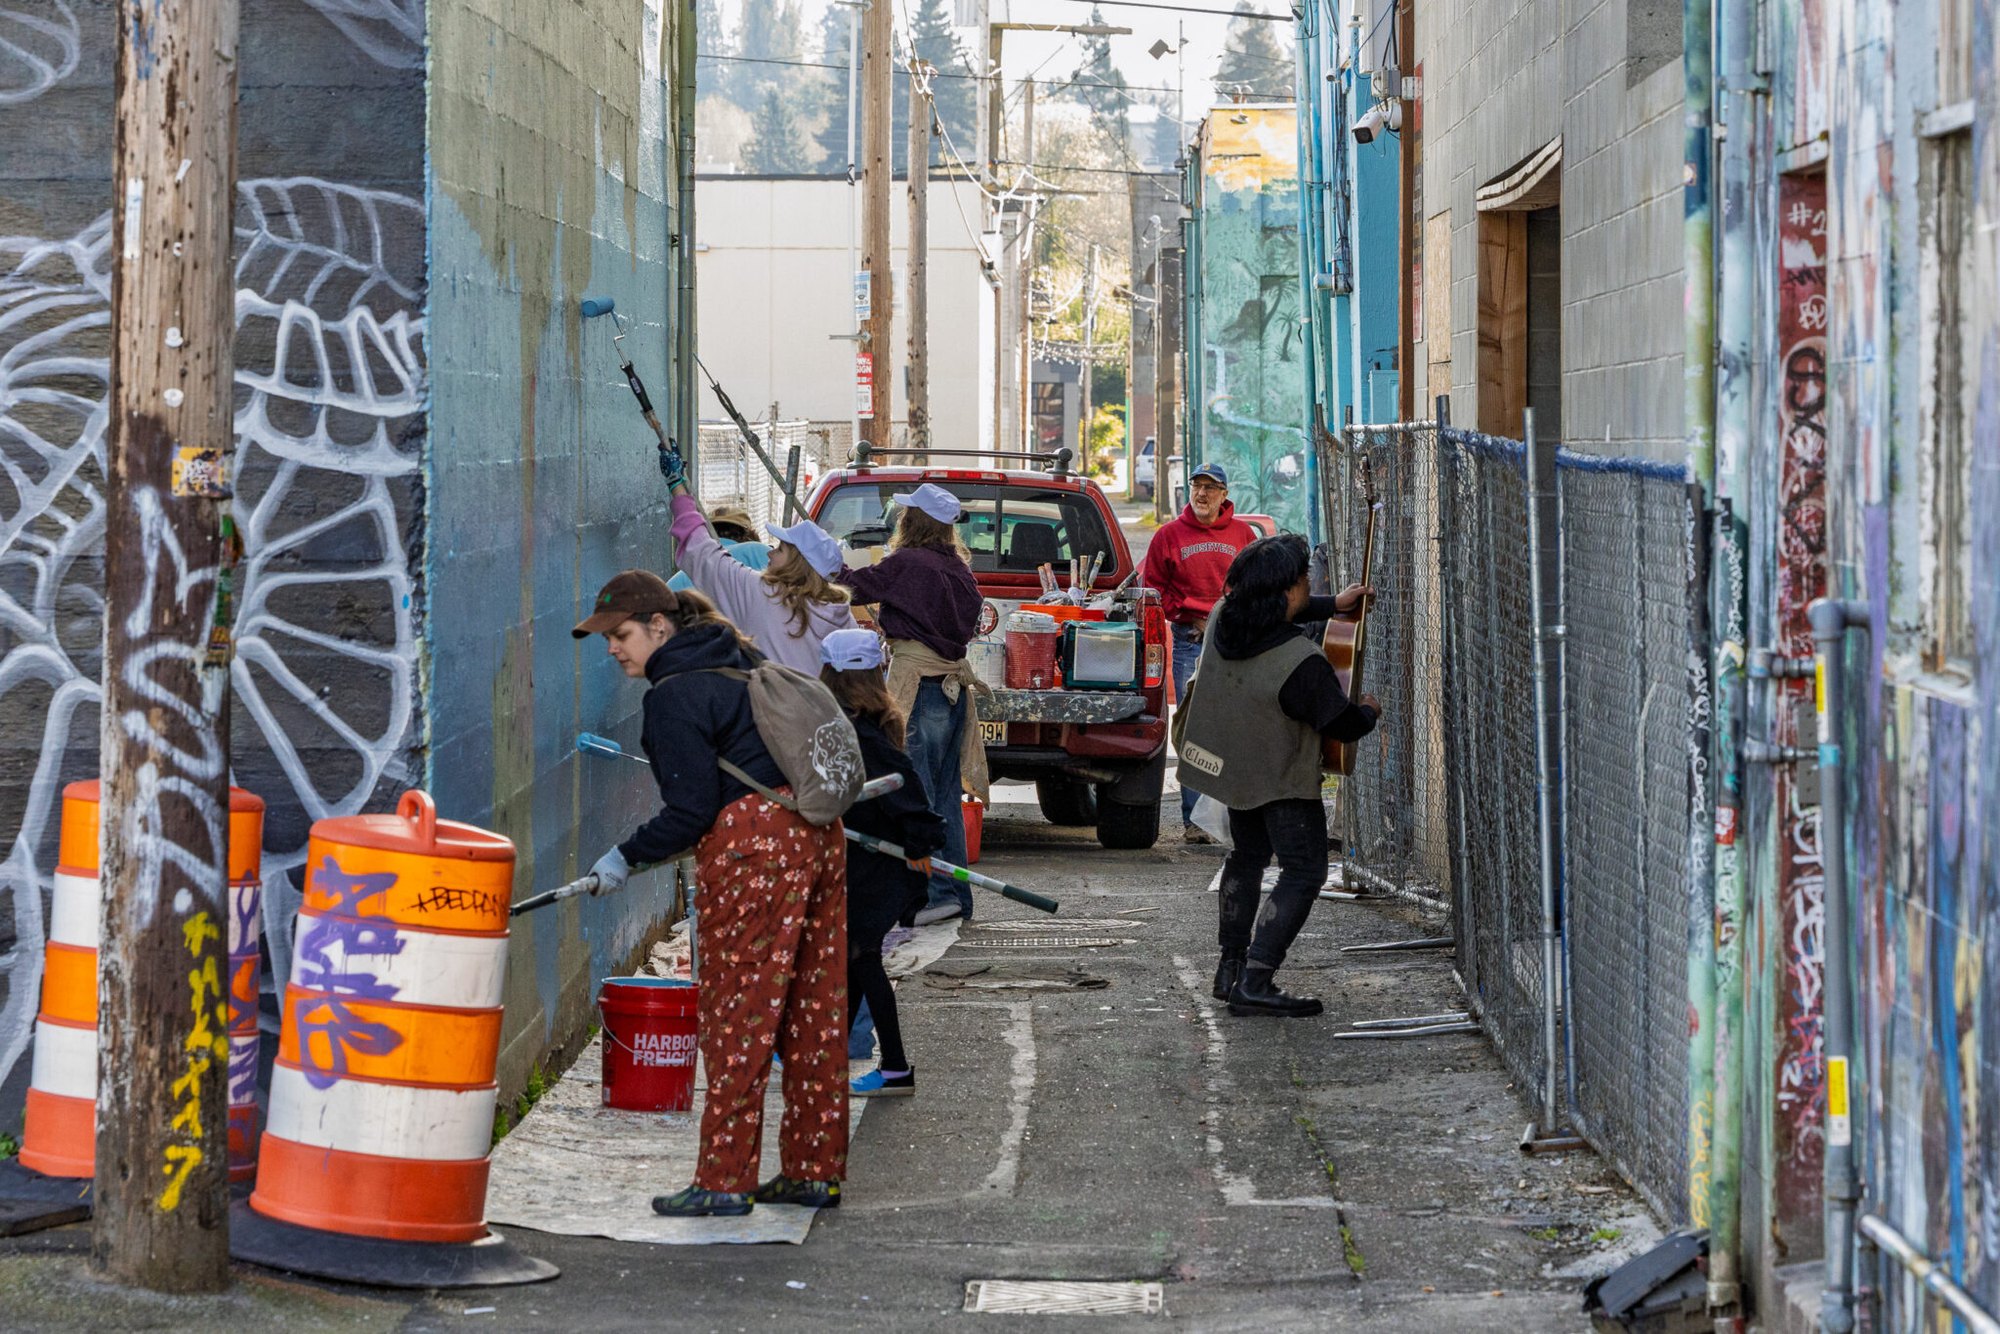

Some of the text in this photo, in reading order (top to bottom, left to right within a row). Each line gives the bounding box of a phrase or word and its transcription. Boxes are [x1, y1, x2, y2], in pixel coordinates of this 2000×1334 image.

[1185, 747, 1219, 774] Cloud
[634, 1033, 697, 1051] HARBOR
[632, 1049, 696, 1067] FREIGHT
